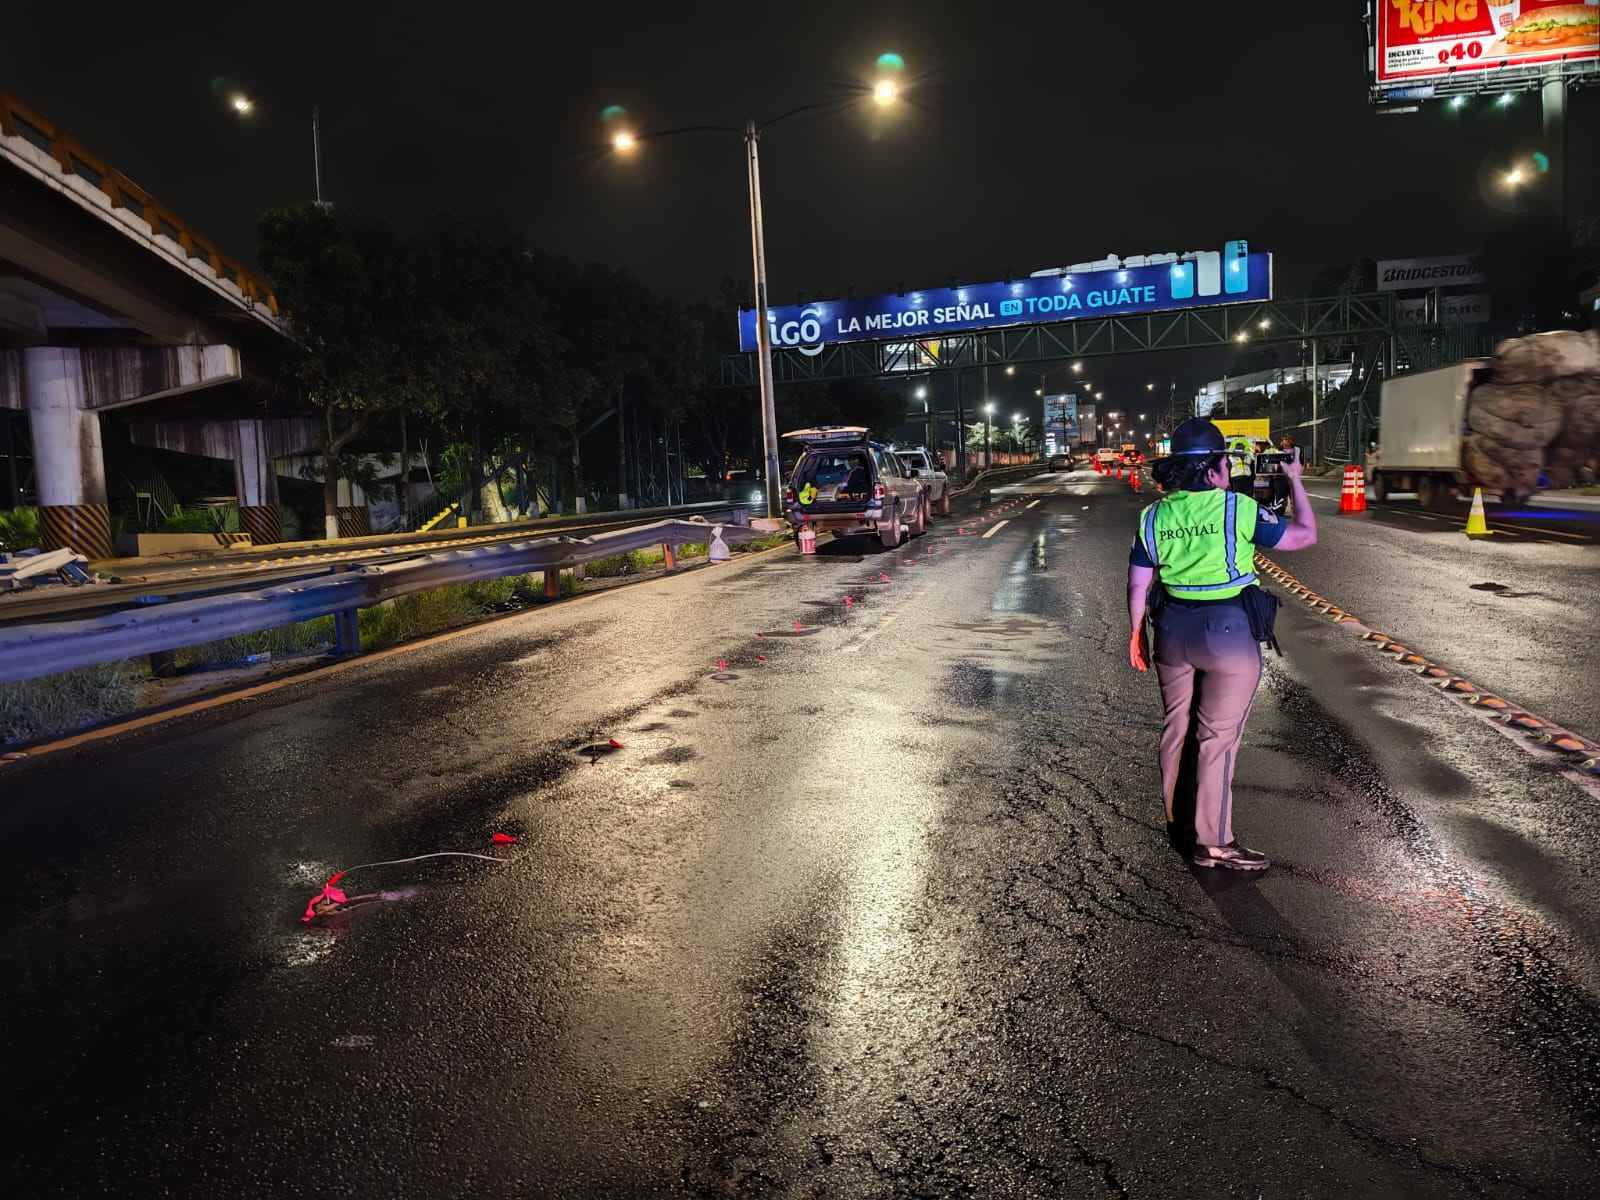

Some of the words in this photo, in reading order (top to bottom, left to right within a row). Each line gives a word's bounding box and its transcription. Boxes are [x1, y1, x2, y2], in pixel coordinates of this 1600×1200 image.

[1393, 0, 1478, 35] KING
[837, 317, 860, 334] LA
[865, 310, 929, 330] MEJOR
[933, 302, 995, 324] SEÑAL
[1004, 302, 1019, 313] EN
[1025, 293, 1081, 313] TODA
[1087, 285, 1156, 308] GUATE
[1160, 524, 1218, 541] PROVIAL
